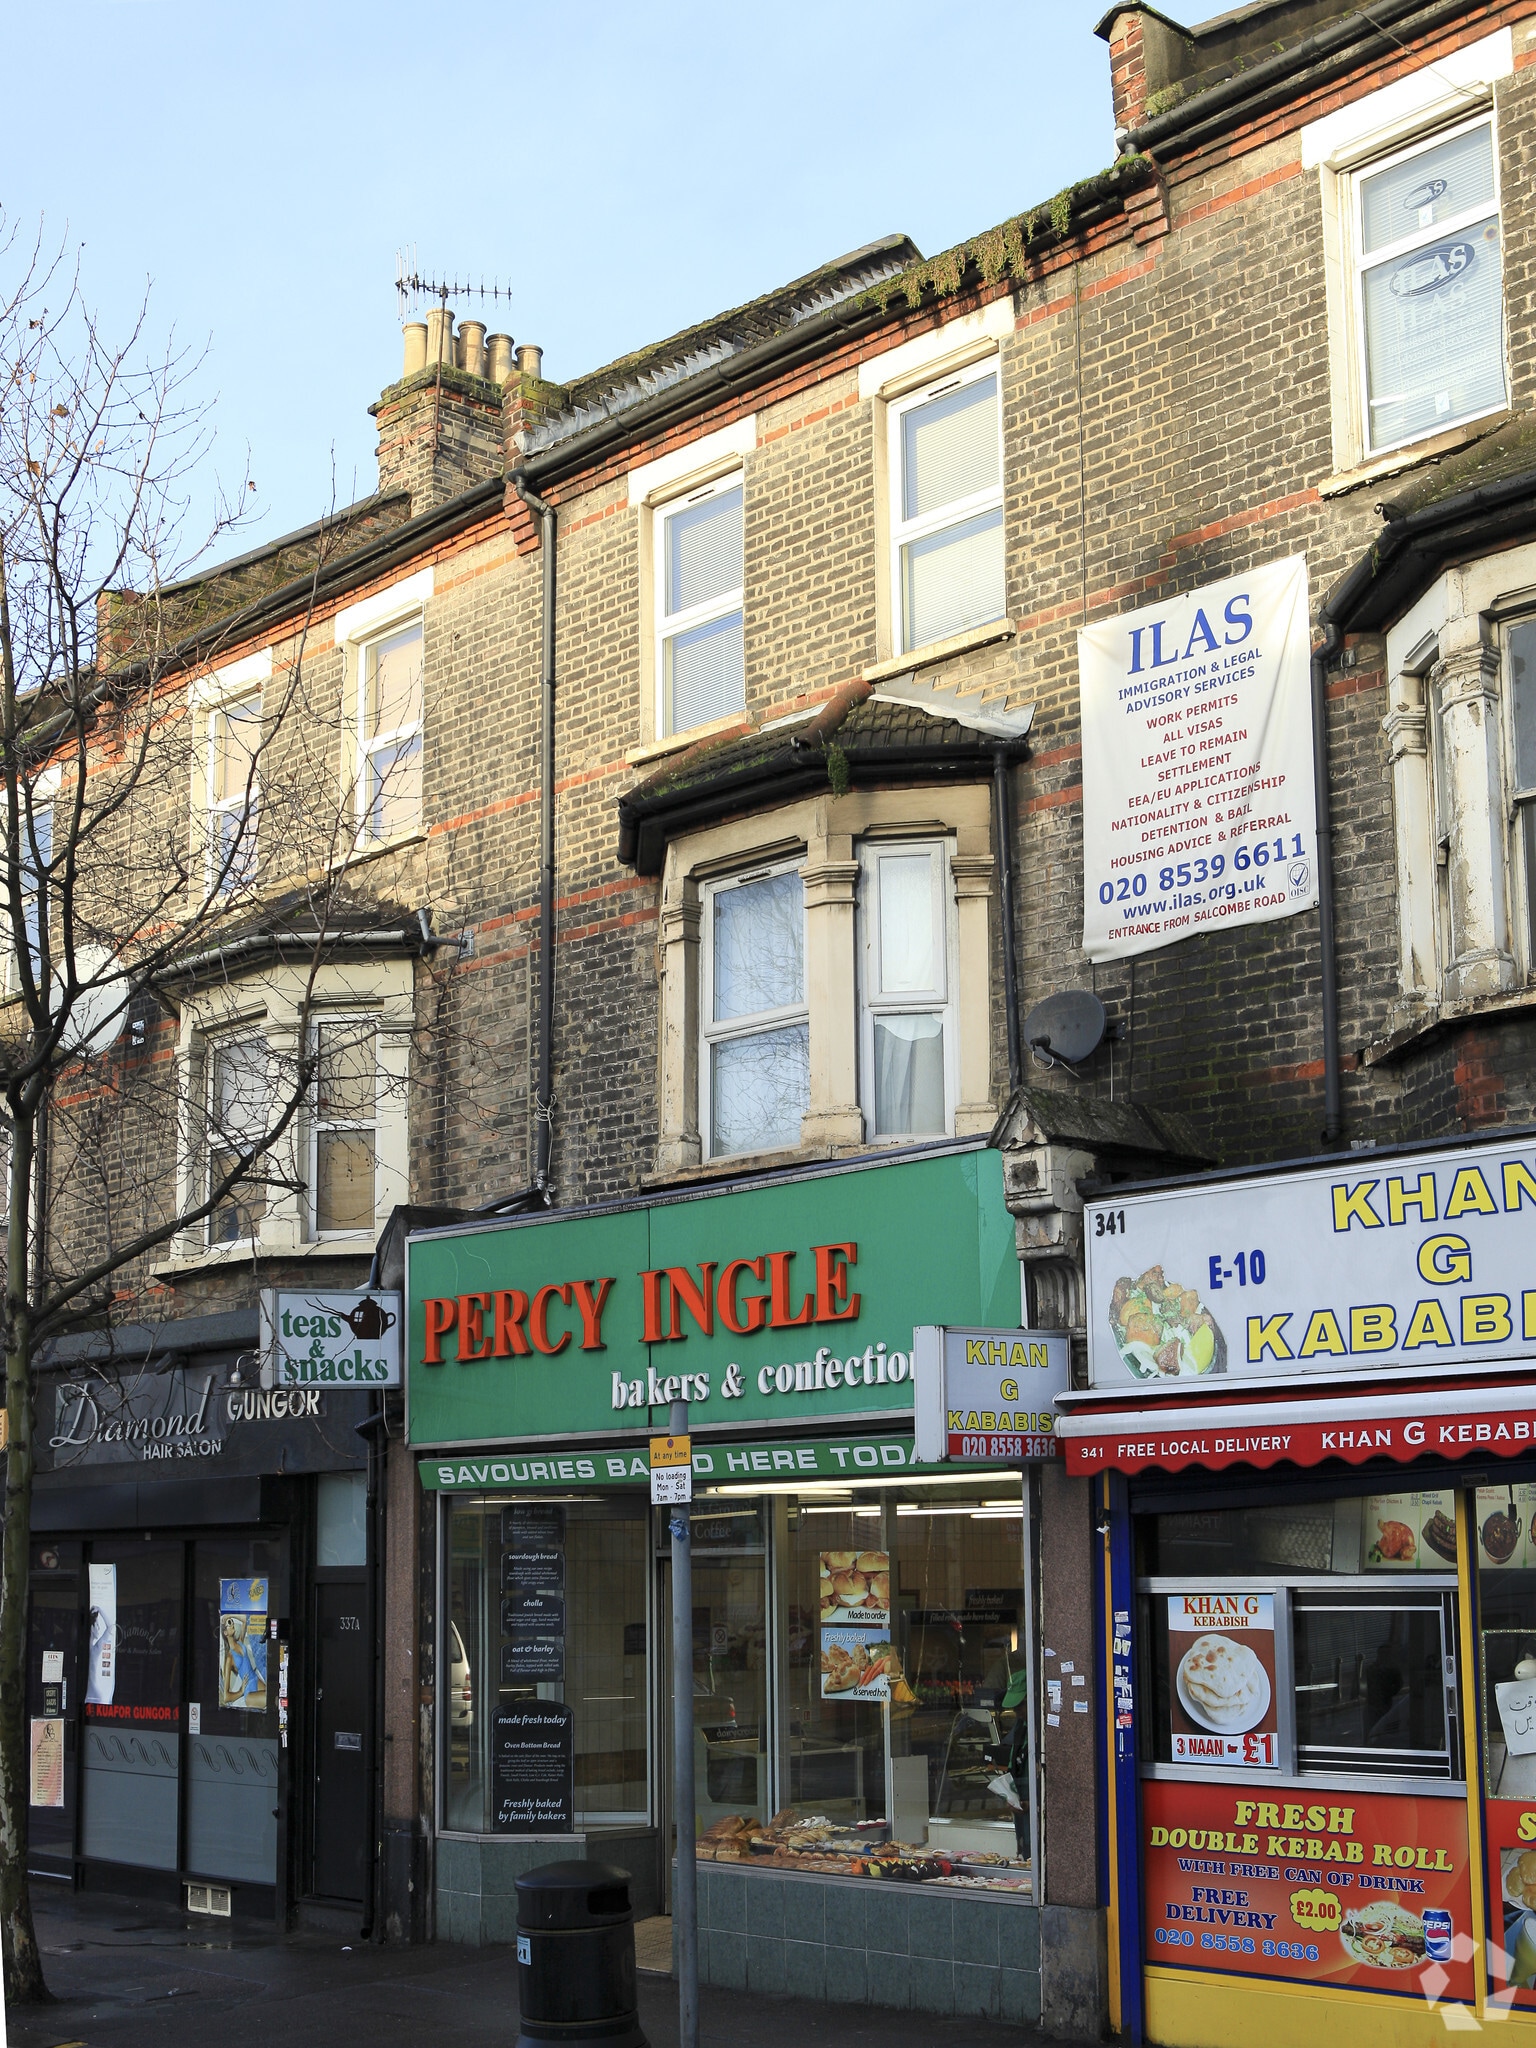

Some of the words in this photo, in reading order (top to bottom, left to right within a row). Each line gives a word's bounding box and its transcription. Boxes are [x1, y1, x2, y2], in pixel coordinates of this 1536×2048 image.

[1127, 594, 1253, 675] ILAS
[1118, 665, 1206, 701] IMMIGRATION
[1210, 662, 1220, 673] &
[1224, 648, 1262, 669] LEGAL
[1126, 686, 1190, 714] ADVISORY
[1194, 666, 1255, 694] SERVICES
[1146, 711, 1182, 730] WORK
[1186, 694, 1239, 720] PERMITS
[1163, 730, 1183, 743] ALL
[1187, 717, 1223, 737] VISAS
[1141, 749, 1176, 768] LEAVE
[1181, 744, 1195, 757] TO
[1199, 729, 1248, 751] REMAIN
[1157, 752, 1232, 782] SETTLEMENT
[1128, 788, 1171, 809] EEA/EU
[1175, 761, 1261, 796] APPLICATIONS
[1111, 802, 1189, 832] NATIONALITY
[1193, 799, 1202, 810] &
[1206, 775, 1286, 806] CITIZENSHIP
[1141, 815, 1208, 843] DETENTION
[1215, 812, 1224, 823] &
[1227, 803, 1252, 820] BAIL
[1110, 847, 1164, 869] HOUSING
[1167, 834, 1212, 855] ADVICE
[1217, 831, 1227, 842] &
[1230, 813, 1291, 839] REFERRAL
[1100, 873, 1147, 905] 020
[1159, 854, 1225, 891] 8539
[1234, 833, 1305, 872] 6611
[1123, 874, 1266, 920] www.ilas.org.uk
[1108, 922, 1160, 940] ENTRANCE
[1163, 914, 1190, 931] FROM
[1194, 901, 1250, 923] SALCOMBE
[1254, 892, 1286, 909] ROAD
[1331, 1159, 1536, 1233] KHAN
[1095, 1210, 1126, 1237] 341
[1208, 1249, 1266, 1290] E-10
[1417, 1233, 1472, 1285] G
[420, 1277, 616, 1364] PERCY
[637, 1241, 862, 1344] INGLE
[280, 1308, 342, 1338] teas
[309, 1338, 325, 1358] &
[966, 1339, 1048, 1368] KHAN
[284, 1349, 389, 1381] snacks
[611, 1366, 710, 1410] bakers
[720, 1362, 746, 1399] &
[757, 1341, 915, 1394] confectio
[1000, 1378, 1018, 1401] G
[49, 1375, 215, 1449] Diamond
[227, 1390, 319, 1421] GUNGOR
[948, 1410, 1058, 1432] KABABIS
[142, 1443, 173, 1460] HAIR
[177, 1438, 223, 1458] SALON
[962, 1436, 987, 1456] 020
[990, 1437, 1022, 1457] 8558
[1025, 1437, 1056, 1457] 3636
[1081, 1446, 1104, 1458] 341
[1117, 1442, 1158, 1458] FREE
[1160, 1439, 1211, 1455] LOCAL
[1214, 1435, 1292, 1453] DELIVERY
[1321, 1428, 1392, 1450] KHAN
[1403, 1421, 1426, 1445] G
[437, 1459, 595, 1485] SAVOURIES
[606, 1453, 715, 1478] BAD
[726, 1448, 819, 1472] HERE
[653, 1452, 661, 1460] At
[674, 1450, 687, 1459] time
[655, 1472, 665, 1480] No
[666, 1472, 687, 1481] loading
[656, 1483, 669, 1491] Mon
[675, 1481, 686, 1490] Sat
[674, 1493, 686, 1502] 7pm
[508, 1553, 539, 1562] sourdough
[523, 1599, 543, 1607] cholla
[848, 1610, 864, 1619] Made
[871, 1611, 886, 1620] order
[1182, 1596, 1240, 1615] KHAN
[1243, 1596, 1259, 1615] G
[340, 1617, 360, 1630] 337A
[1193, 1616, 1250, 1628] KEBABISH
[524, 1645, 533, 1653] &
[533, 1645, 554, 1655] barley
[825, 1632, 846, 1645] Freshly
[846, 1632, 866, 1643] baked
[853, 1687, 858, 1696] &
[858, 1688, 877, 1697] served
[877, 1688, 887, 1697] hot
[96, 1705, 131, 1718] KUAFOR
[133, 1706, 170, 1720] GUNGOR
[498, 1714, 521, 1724] made
[521, 1714, 543, 1726] fresh
[543, 1715, 567, 1727] today
[543, 1741, 561, 1749] Bread
[1176, 1738, 1186, 1755] 3
[1188, 1739, 1224, 1757] NAAN
[1227, 1745, 1238, 1755] for
[1242, 1733, 1273, 1765] £1
[498, 1811, 509, 1823] by
[509, 1811, 537, 1823] family
[537, 1811, 566, 1820] bakers
[503, 1799, 535, 1810] Freshly
[535, 1798, 562, 1808] baked
[1234, 1801, 1355, 1835] FRESH
[1150, 1826, 1260, 1856] DOUBLE
[1267, 1836, 1364, 1864] KEBAB
[1373, 1844, 1454, 1873] ROLL
[1177, 1858, 1224, 1875] WITH
[1229, 1862, 1280, 1881] FREE
[1284, 1867, 1322, 1885] CAN
[1327, 1870, 1354, 1887] OF
[1358, 1874, 1425, 1894] DRINK
[1191, 1886, 1250, 1907] FREE
[1295, 1900, 1337, 1919] £2.00
[1166, 1902, 1278, 1930] DELIVERY
[1423, 1919, 1450, 1930] PEPSI
[1154, 1927, 1195, 1948] 020
[1200, 1931, 1256, 1955] 8558
[1262, 1939, 1320, 1961] 3636
